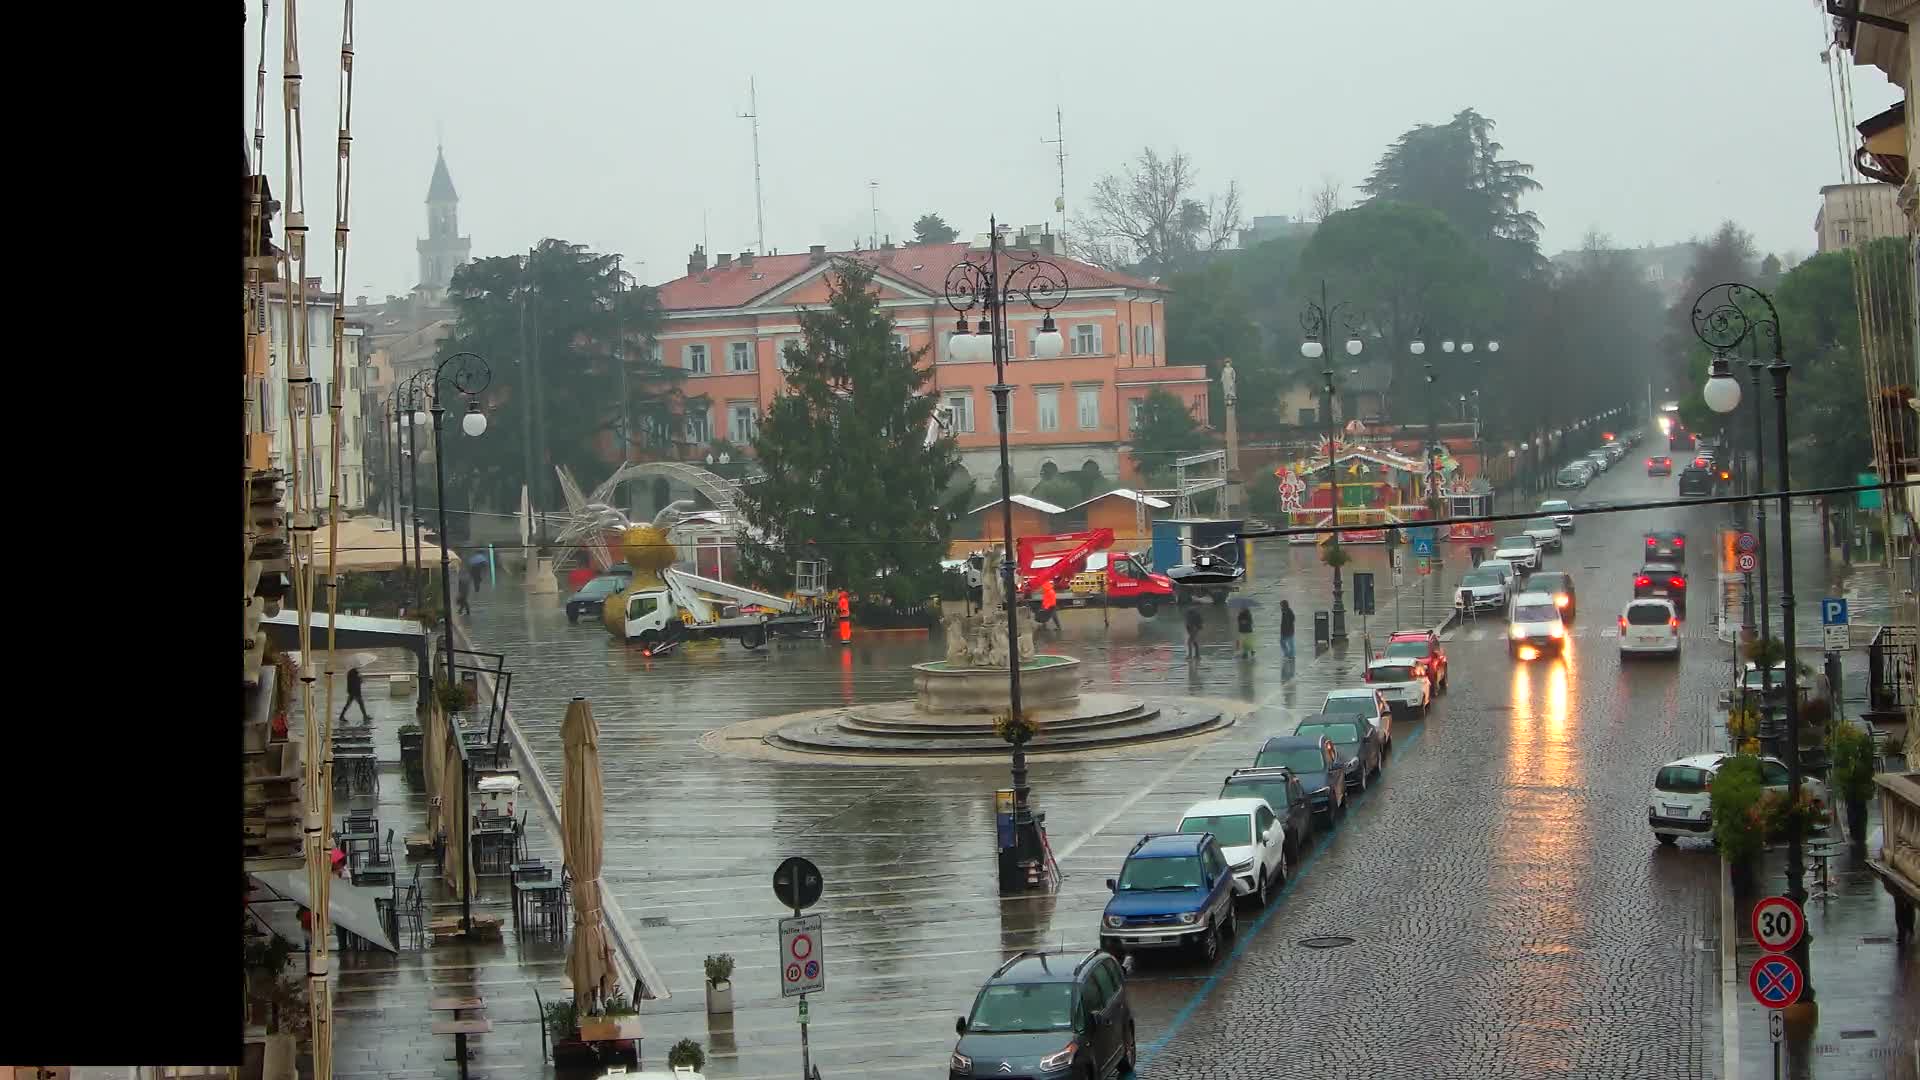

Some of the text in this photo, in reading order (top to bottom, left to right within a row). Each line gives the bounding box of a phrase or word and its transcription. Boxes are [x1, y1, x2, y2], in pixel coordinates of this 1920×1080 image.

[1742, 557, 1753, 567] 20
[1827, 602, 1842, 622] P
[1762, 911, 1791, 938] 30
